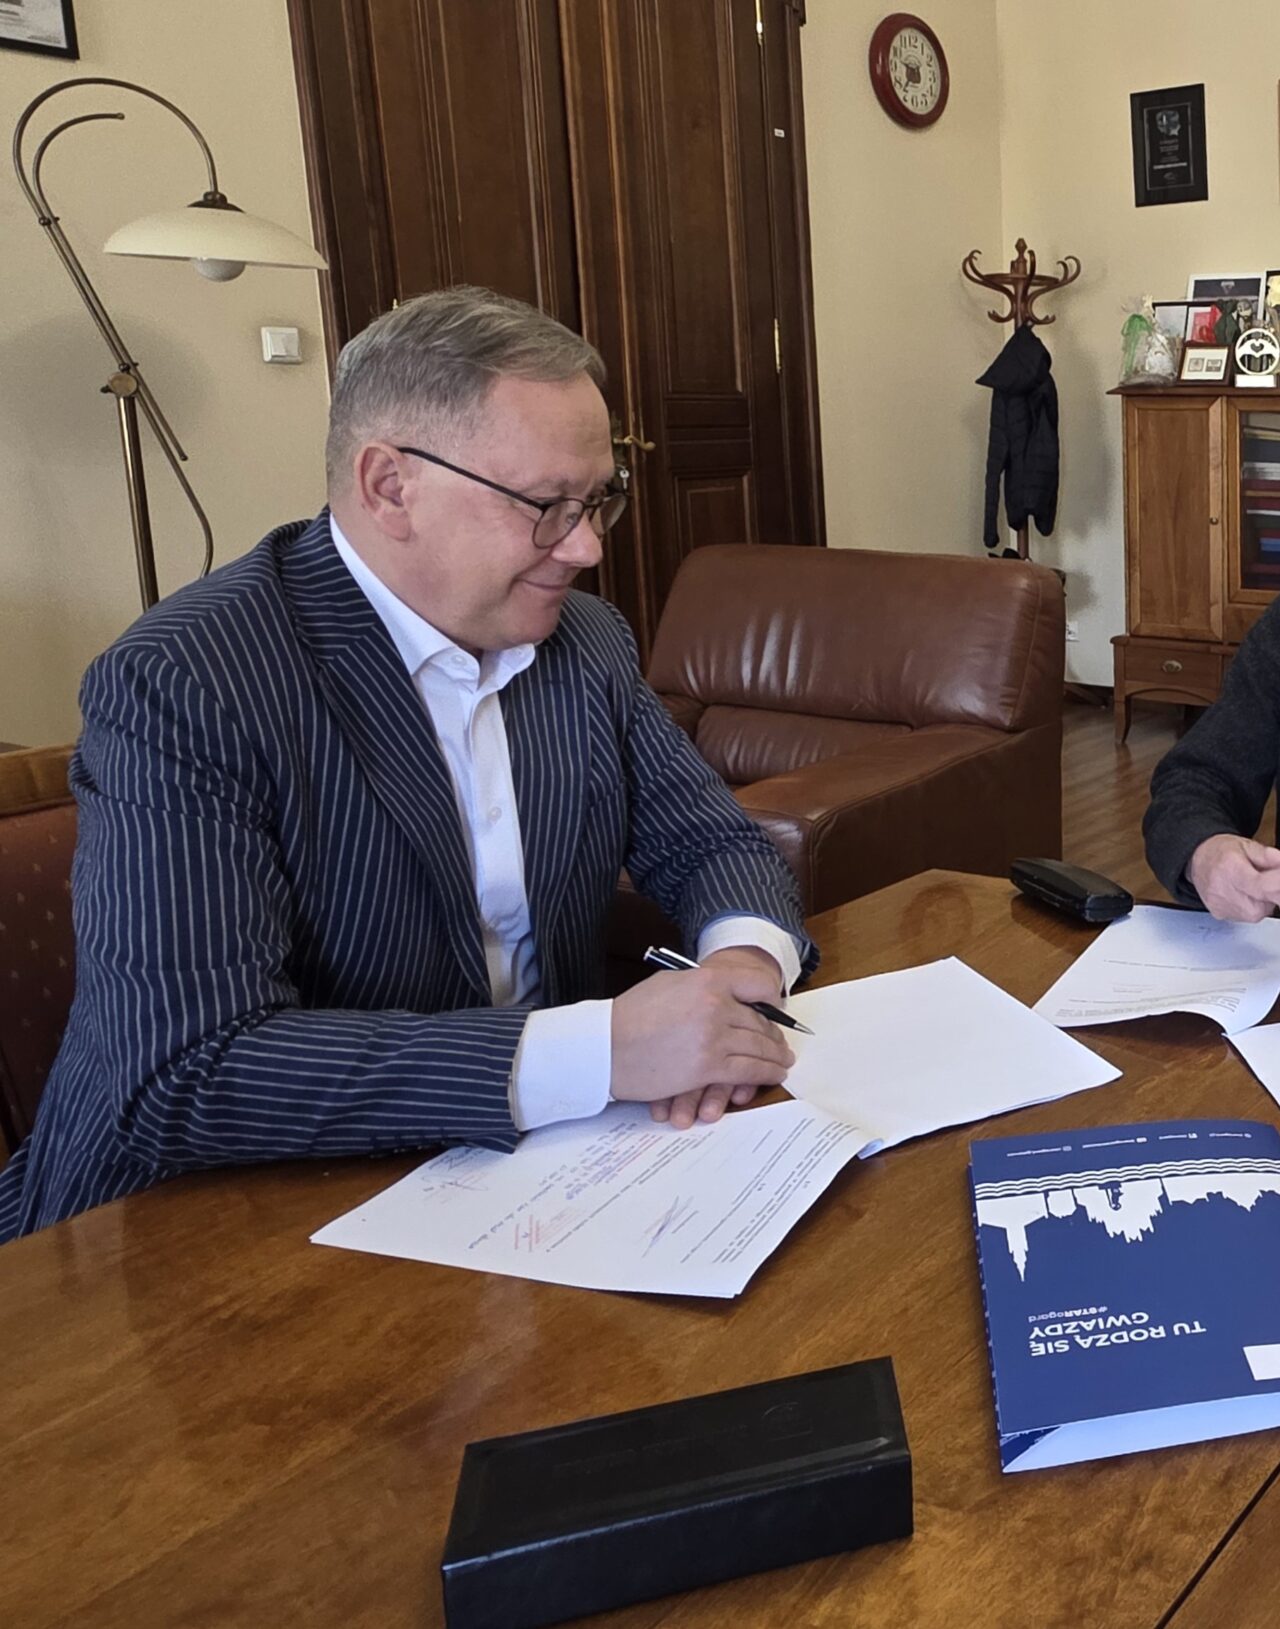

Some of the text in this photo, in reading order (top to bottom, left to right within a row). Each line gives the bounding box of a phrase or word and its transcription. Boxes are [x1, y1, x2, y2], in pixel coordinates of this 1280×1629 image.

[908, 34, 918, 49] 12
[926, 53, 933, 68] 2
[1028, 1306, 1109, 1323] #STARogard
[1029, 1312, 1149, 1339] GWIAZDY
[1029, 1320, 1207, 1357] TU RODZĄ SIĘ
